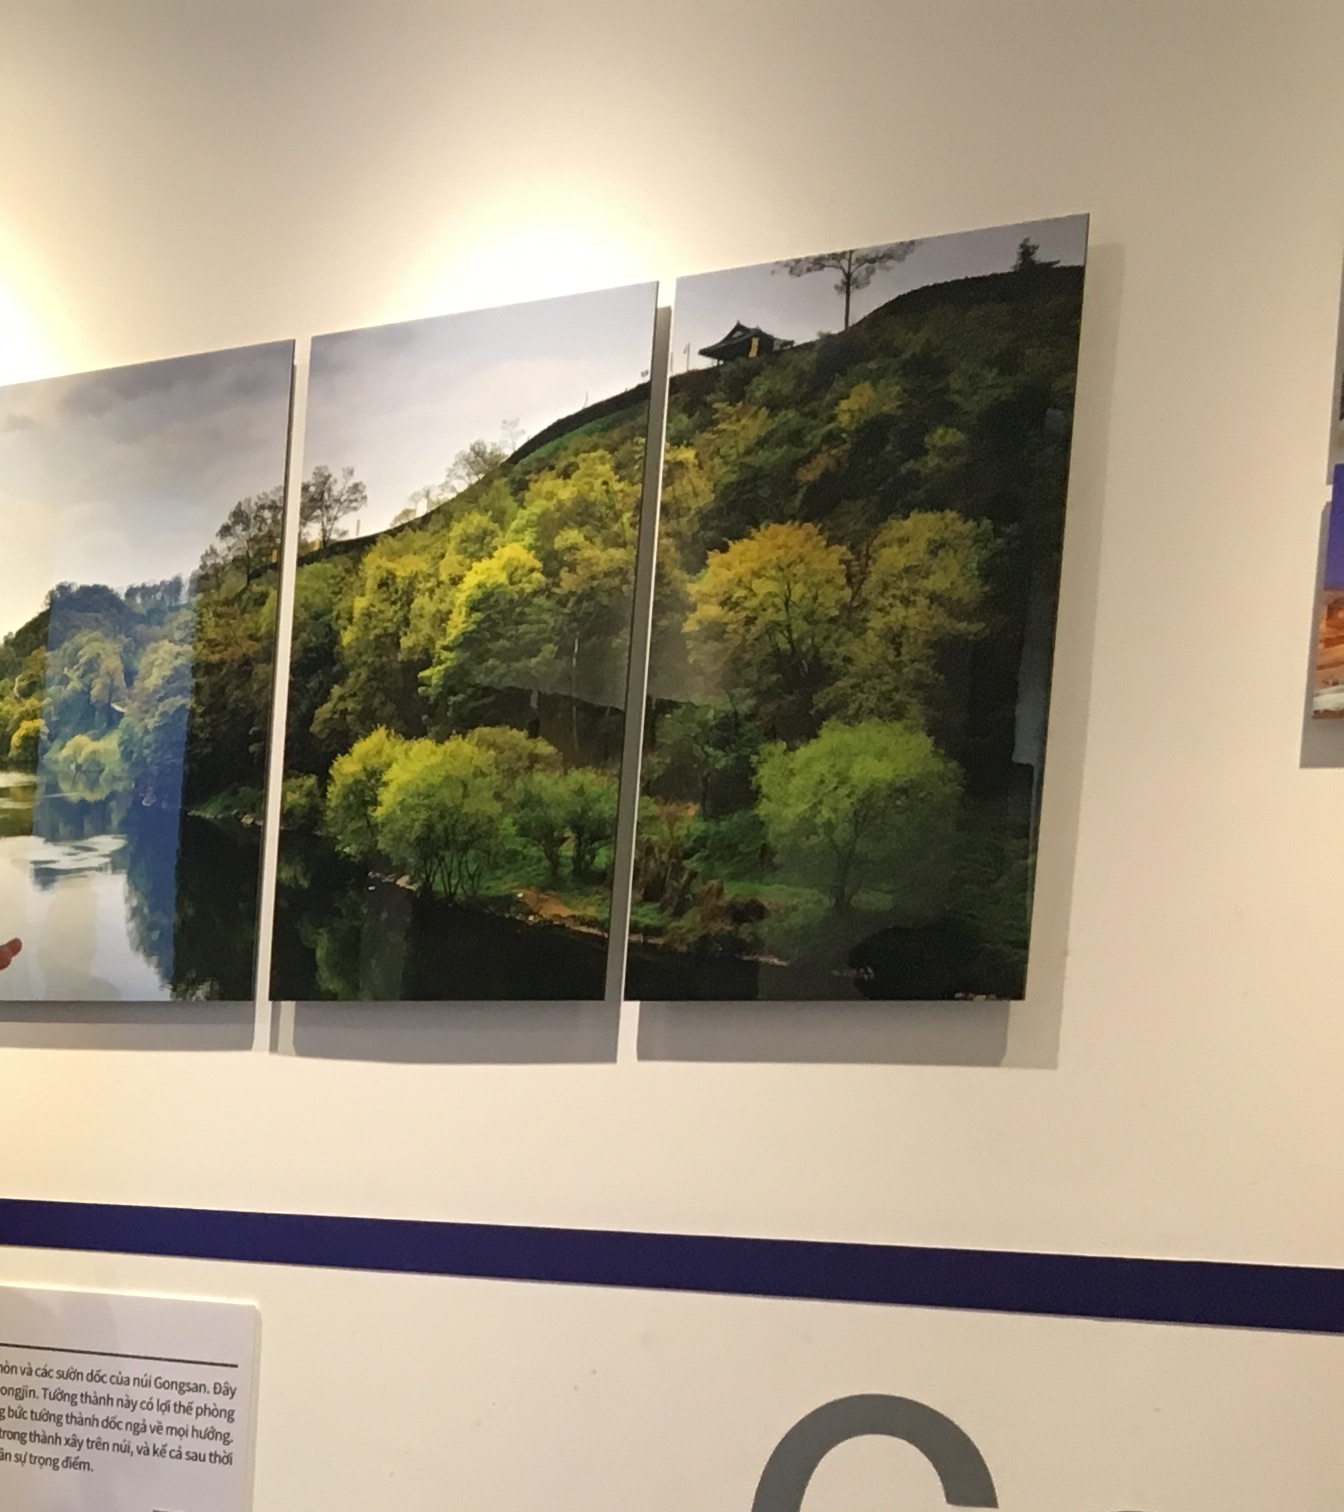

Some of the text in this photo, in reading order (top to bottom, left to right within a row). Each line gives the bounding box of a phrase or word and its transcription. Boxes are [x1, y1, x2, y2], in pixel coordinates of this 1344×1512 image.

[19, 1363, 33, 1376] và
[34, 1364, 54, 1378] các
[55, 1367, 83, 1381] sườn
[85, 1369, 107, 1384] dốc
[108, 1371, 130, 1386] của
[132, 1373, 152, 1388] núi
[153, 1376, 210, 1395] Gongsan.
[213, 1381, 237, 1400] Đây
[7, 1405, 28, 1420] bức
[29, 1408, 63, 1427] tường
[65, 1412, 99, 1427] thành
[101, 1416, 123, 1430] dốc
[165, 1425, 188, 1440] mọi
[79, 1391, 114, 1407] thành
[116, 1394, 138, 1412] này
[139, 1397, 154, 1411] có
[173, 1401, 194, 1415] thế
[195, 1403, 236, 1423] phòng
[13, 1452, 28, 1466] sự
[28, 1453, 59, 1471] trọng
[61, 1456, 94, 1471] điểm.
[28, 1430, 62, 1445] thành
[63, 1434, 84, 1451] xây
[85, 1436, 109, 1451] trên
[111, 1439, 134, 1457] núi,
[135, 1441, 150, 1456] và
[168, 1445, 182, 1460] cả
[184, 1451, 206, 1462] sau
[208, 1450, 233, 1465] thời
